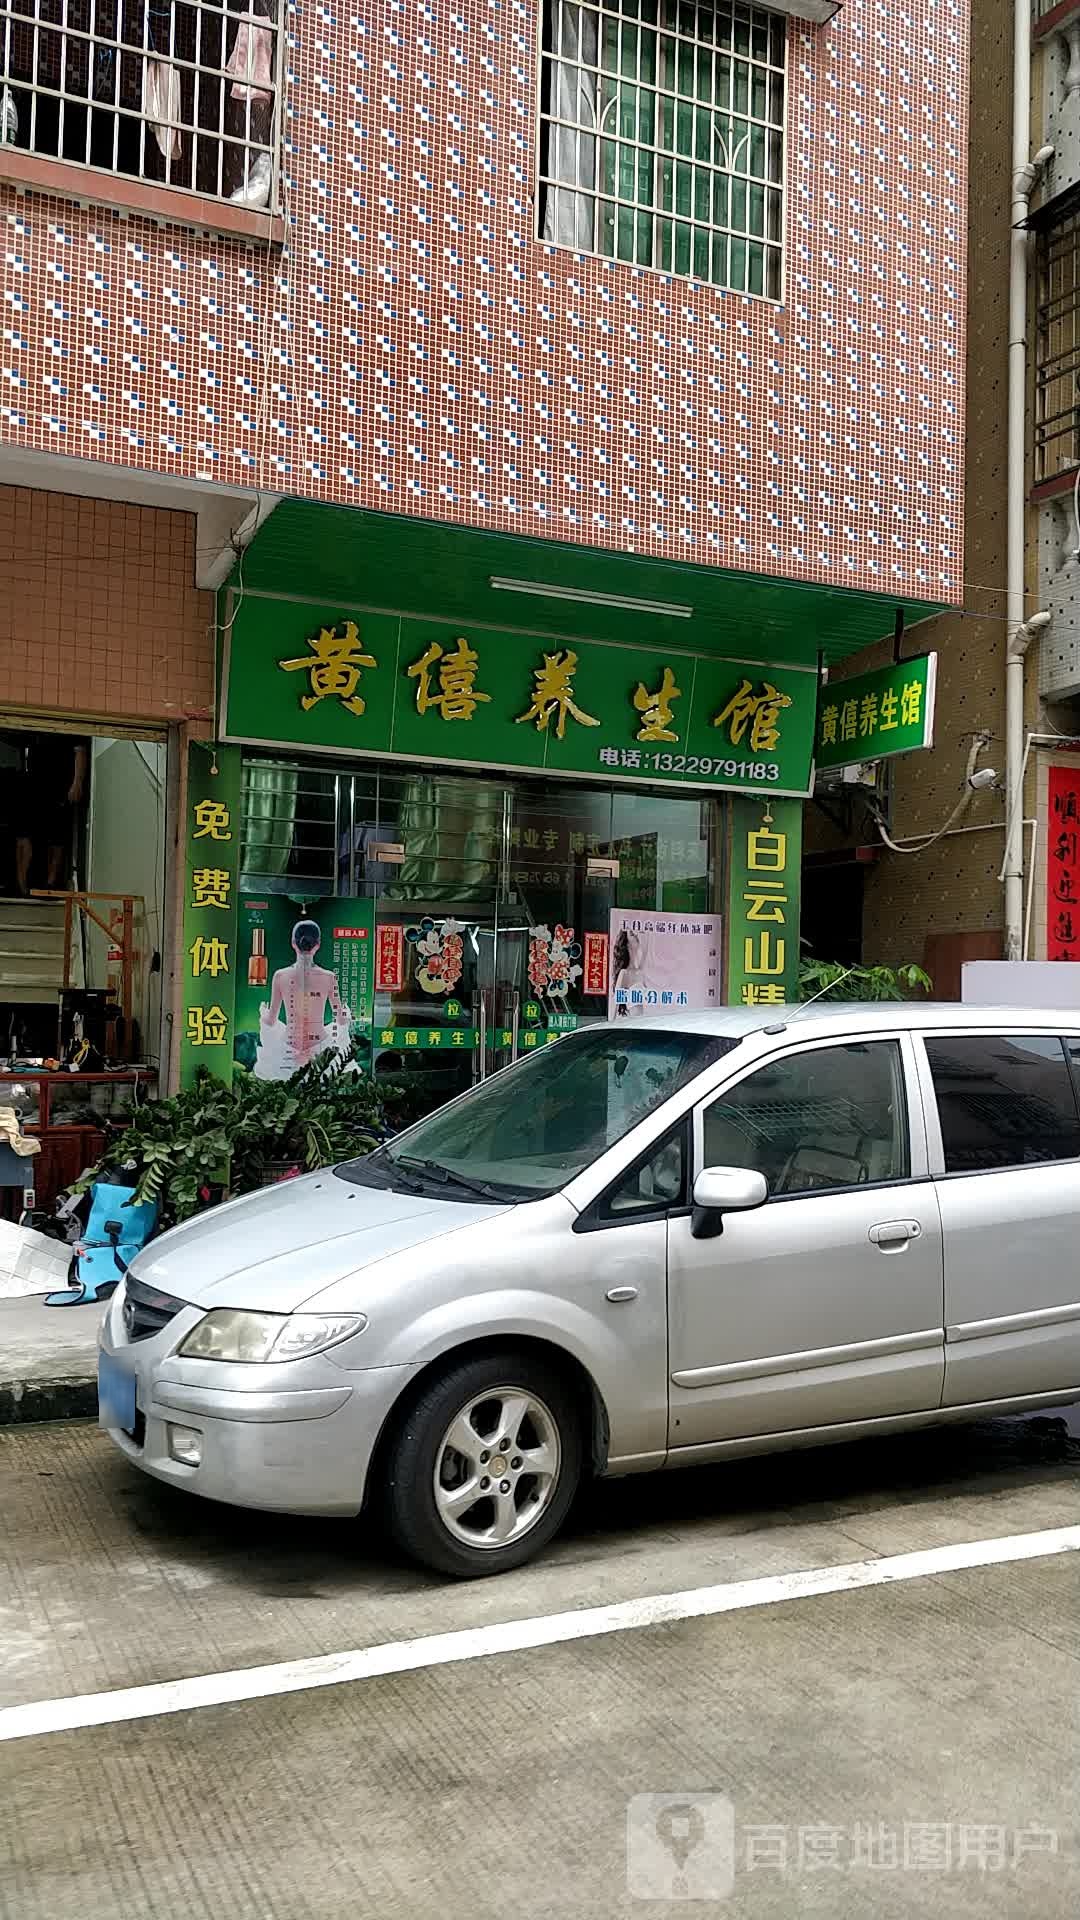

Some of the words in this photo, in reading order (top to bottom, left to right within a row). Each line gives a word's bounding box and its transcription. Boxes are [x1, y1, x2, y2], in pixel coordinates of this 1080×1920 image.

[279, 621, 792, 752] 黄僖养生馆
[600, 747, 779, 781] 电话:13229791183
[186, 799, 232, 1046] 免费体验
[447, 1003, 460, 1016] 拉
[527, 1005, 538, 1018] 拉
